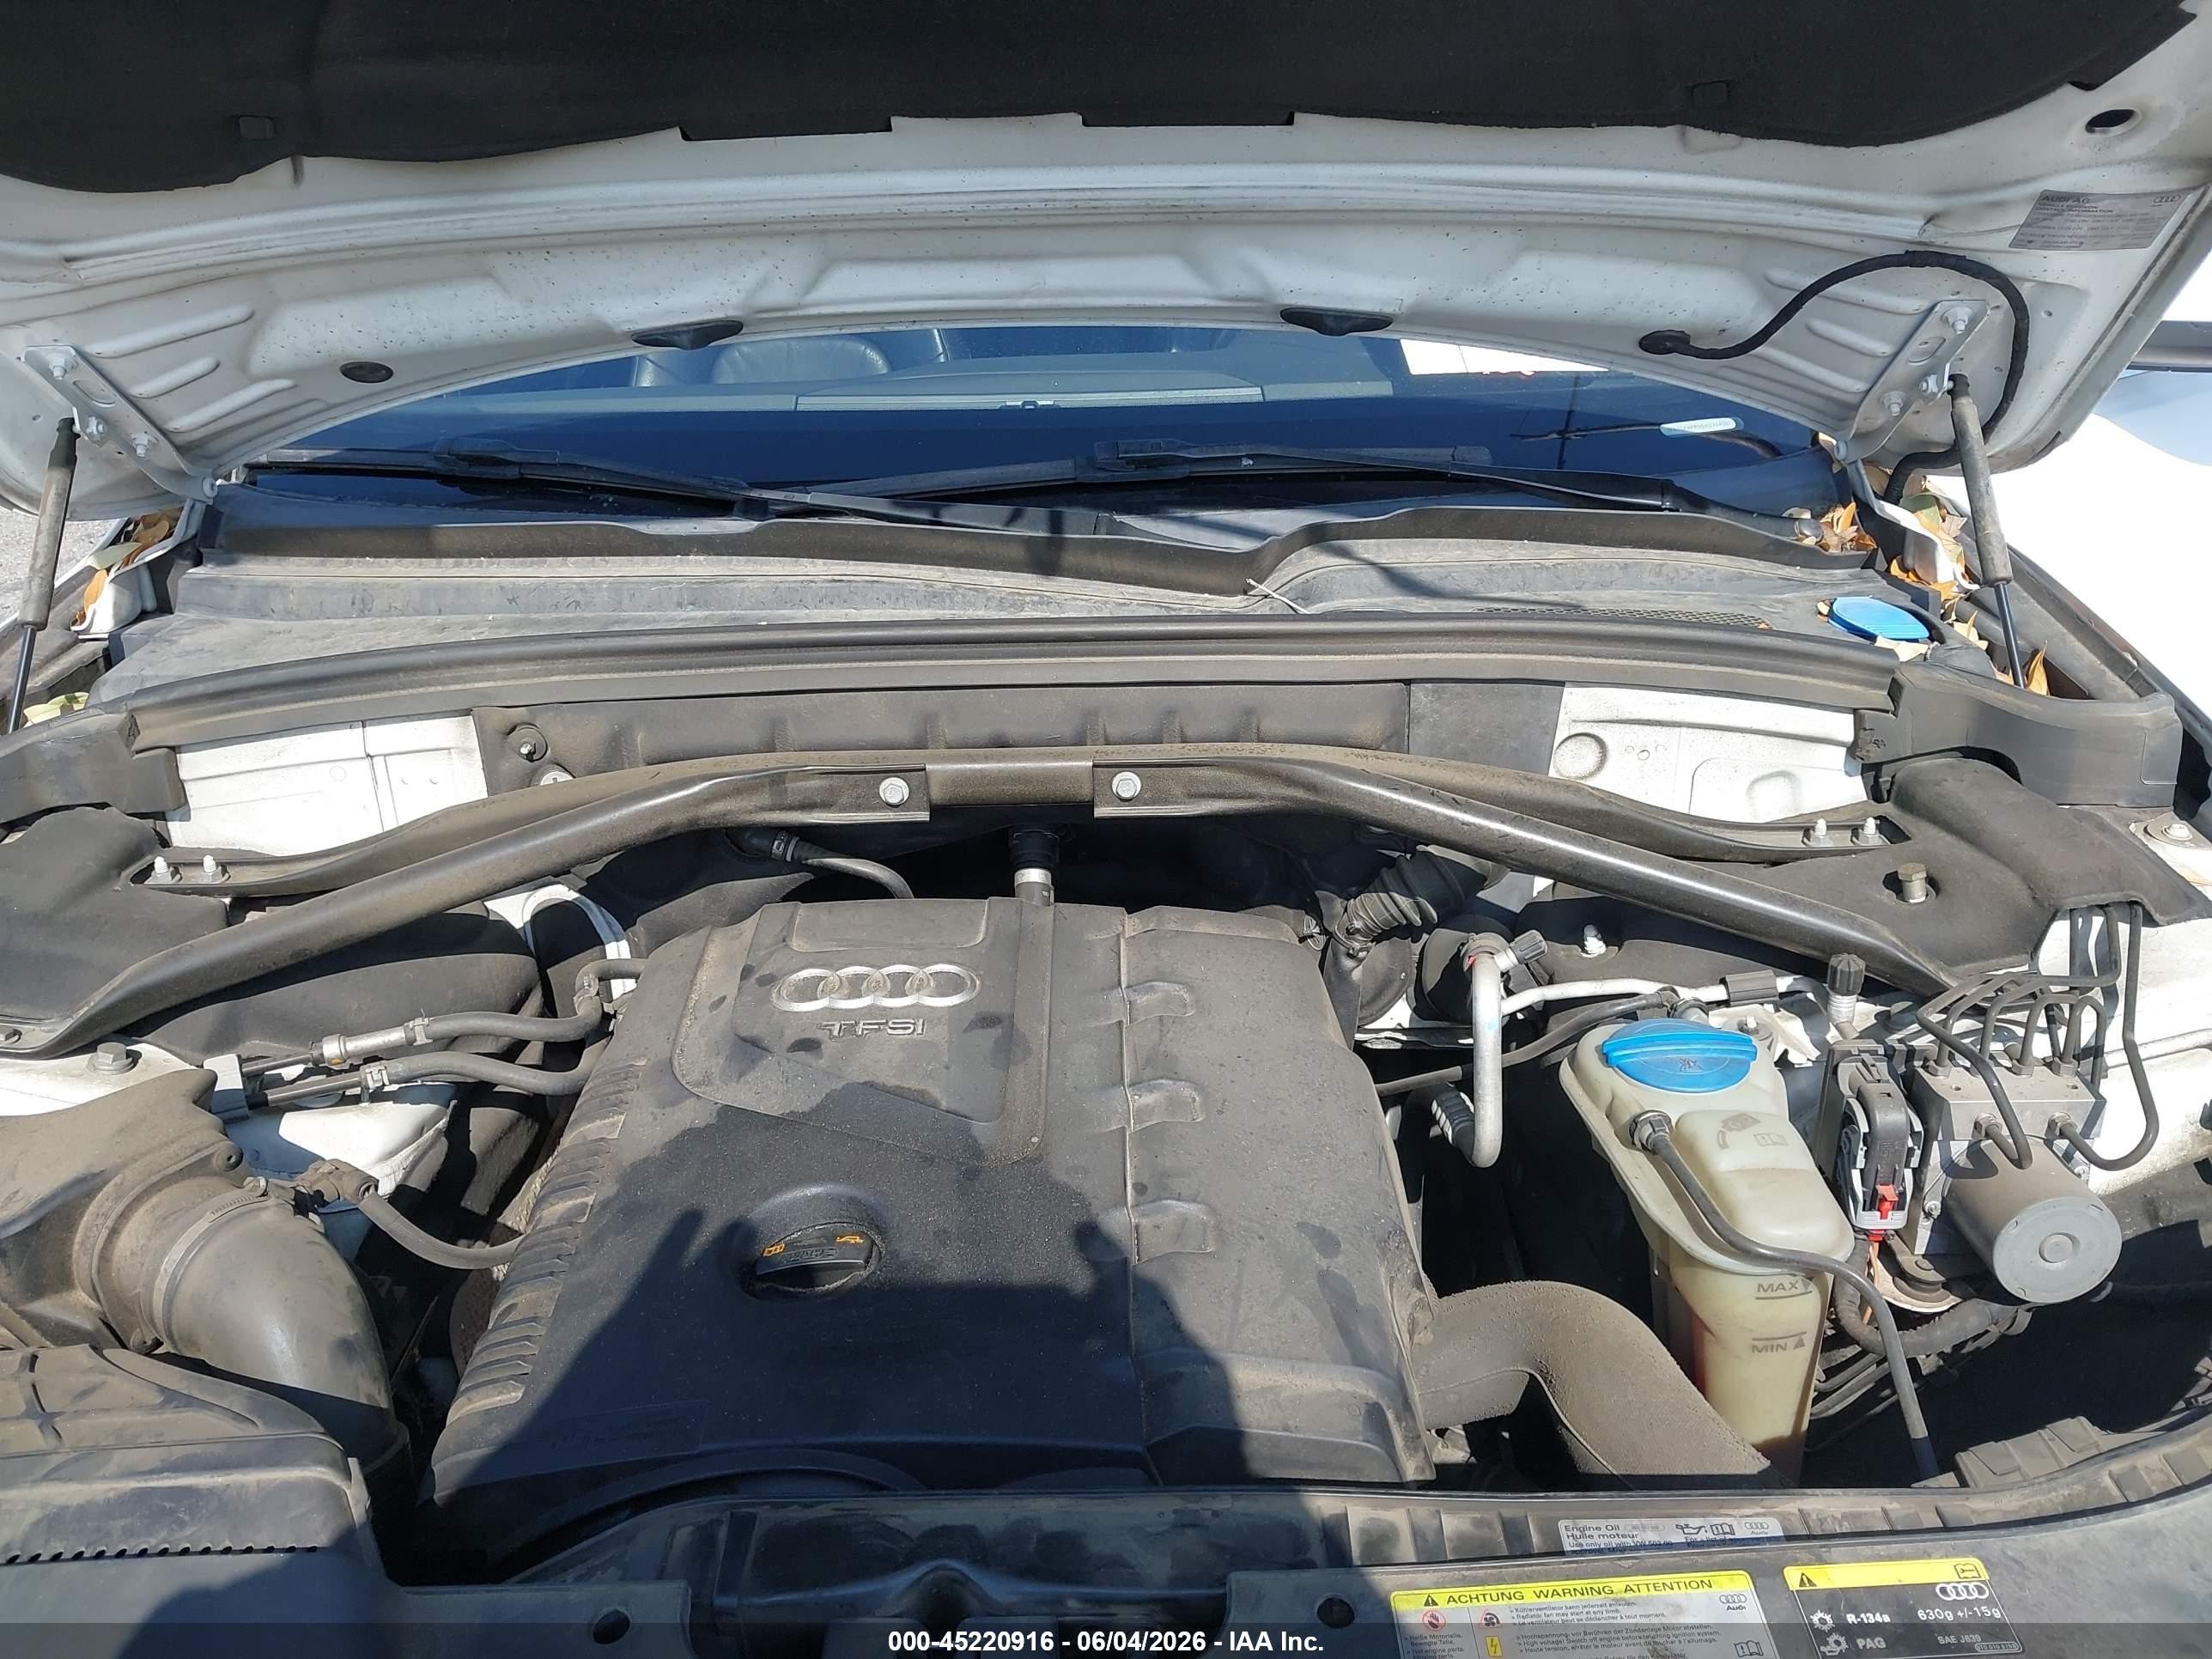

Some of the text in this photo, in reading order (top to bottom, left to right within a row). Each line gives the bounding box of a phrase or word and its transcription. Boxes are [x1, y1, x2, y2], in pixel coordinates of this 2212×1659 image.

[2040, 195, 2070, 204] AUDI
[818, 1018, 927, 1039] TFSI
[1757, 1280, 1800, 1293] MAX
[1751, 1342, 1788, 1353] MIN
[1565, 1524, 1602, 1533] Engine
[1446, 1579, 1714, 1605] ACHTUNG WARNING ATTENTION
[1846, 1612, 1891, 1624] R-134a
[1917, 1608, 1954, 1621] 630g
[1856, 1634, 1982, 1649] PAG SAE J639
